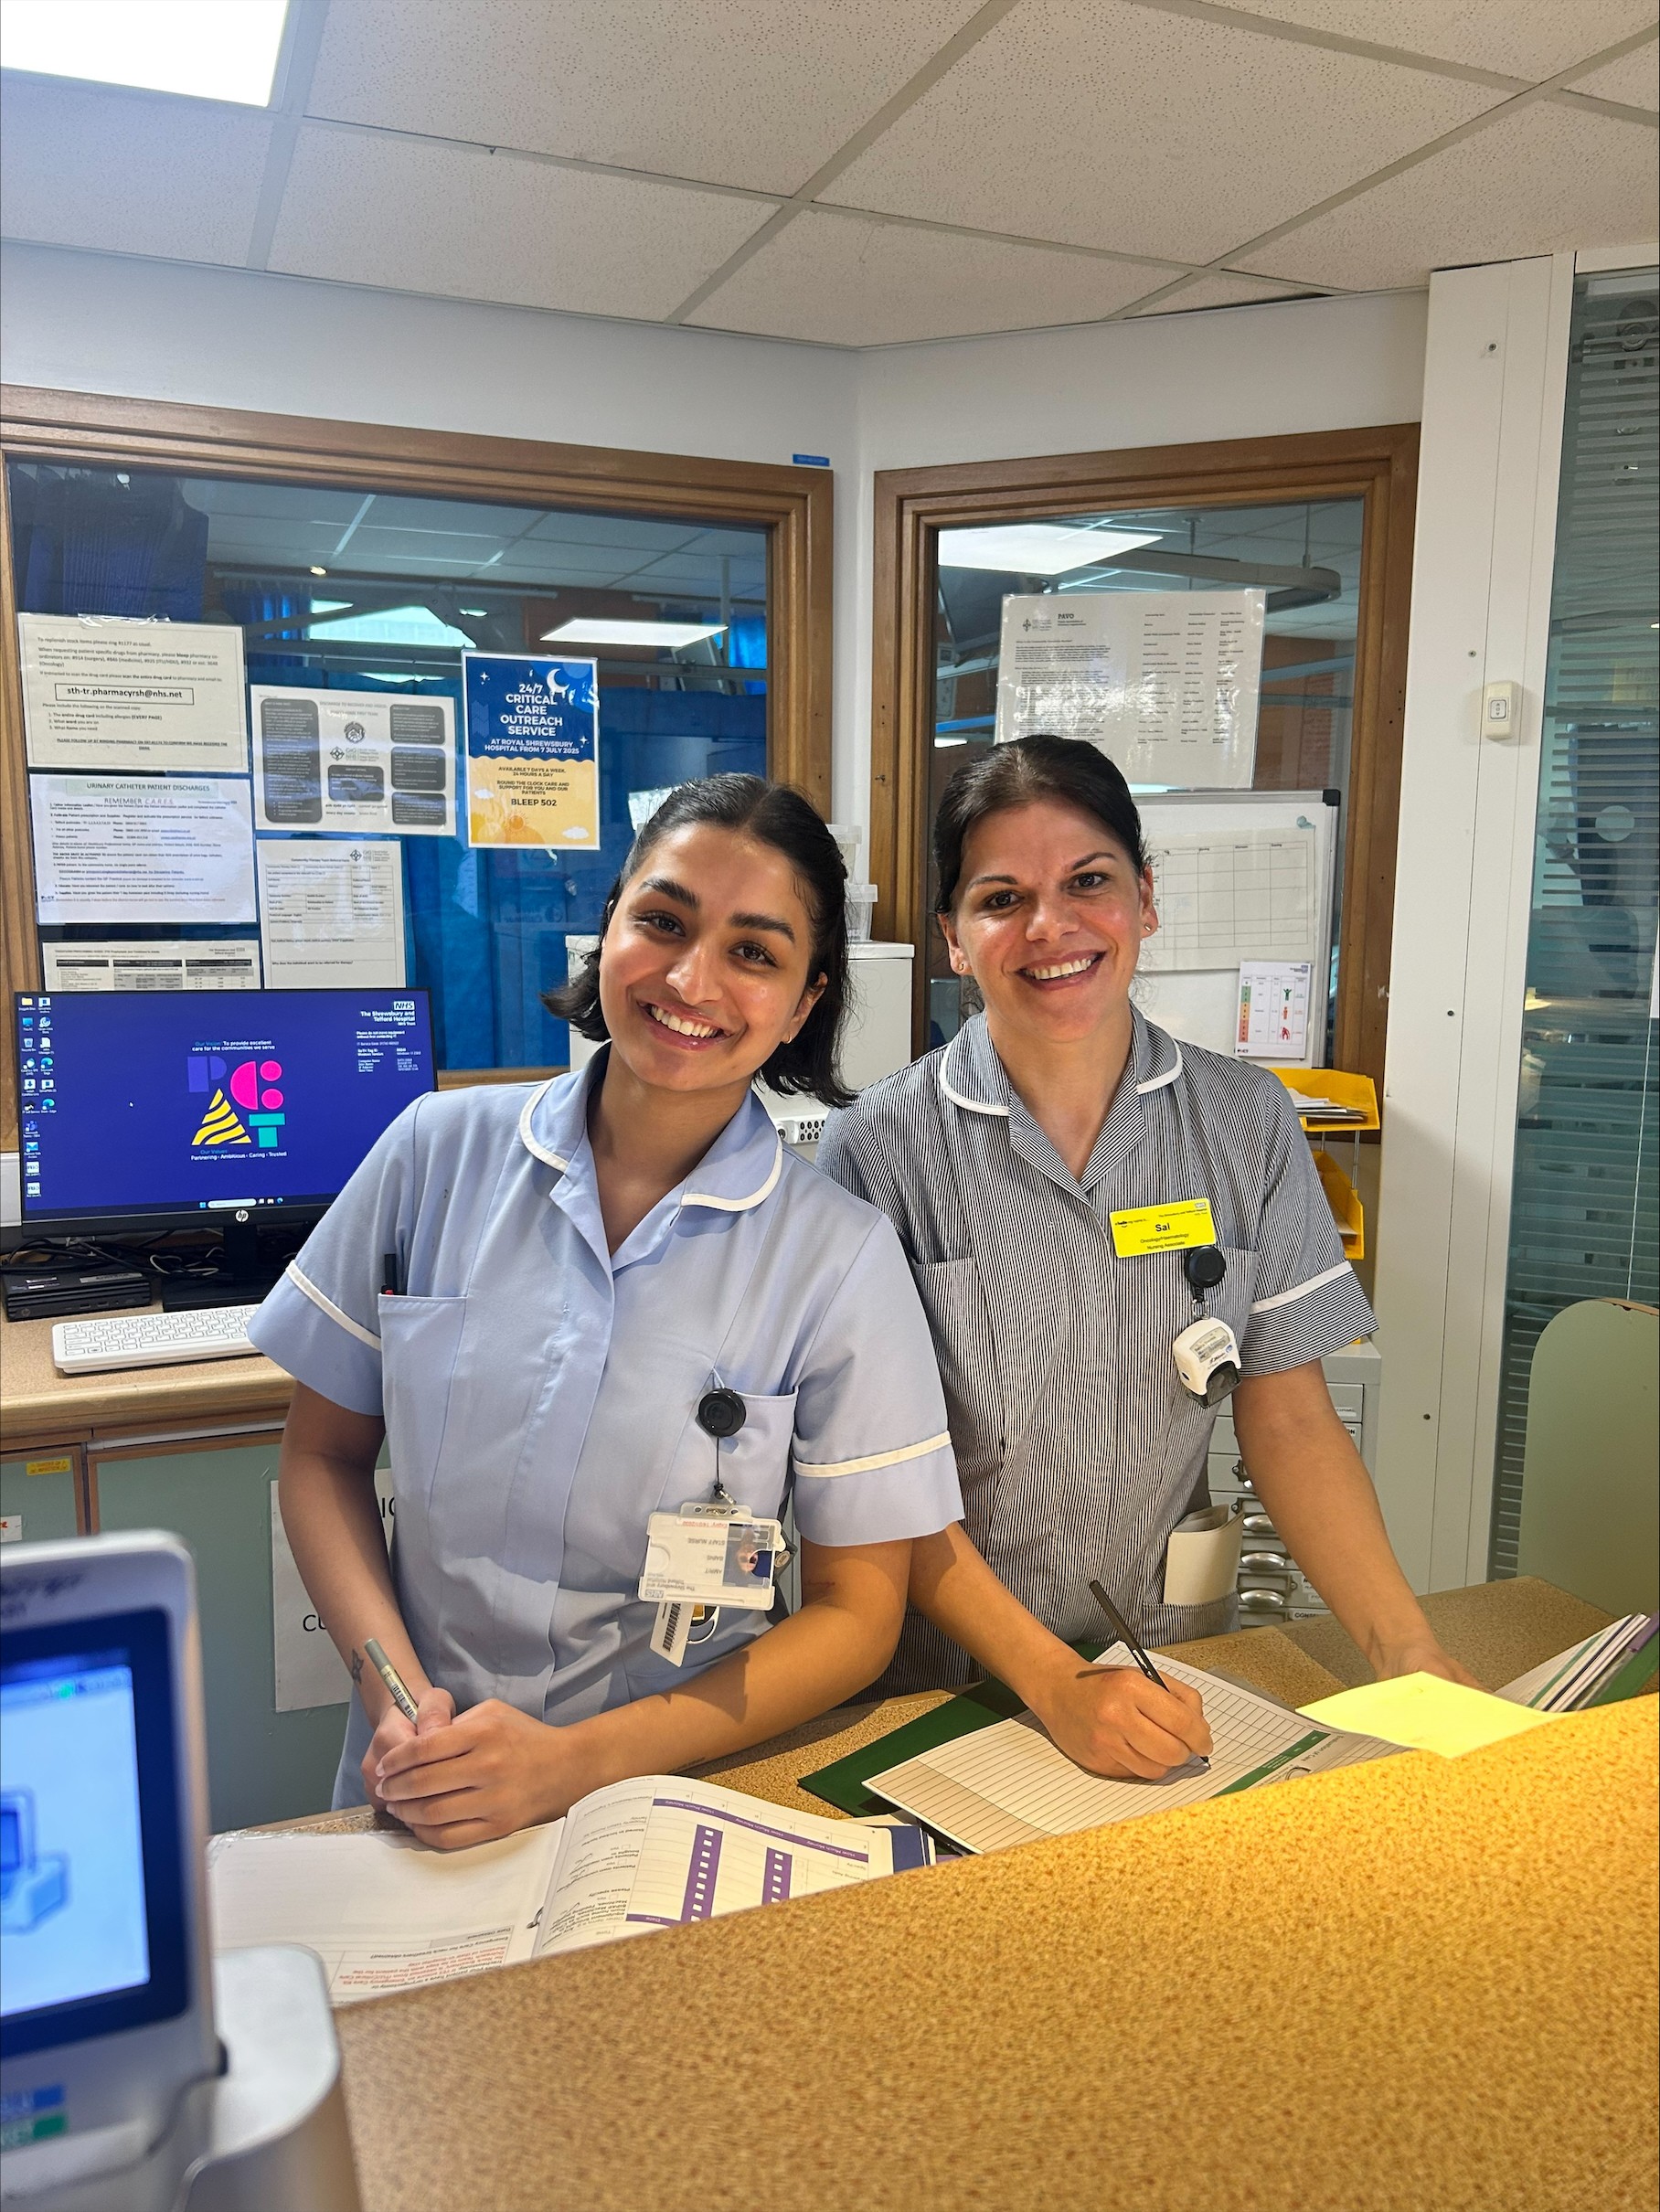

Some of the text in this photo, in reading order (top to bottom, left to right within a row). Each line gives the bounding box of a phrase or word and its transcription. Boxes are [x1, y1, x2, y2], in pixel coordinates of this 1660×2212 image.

[519, 684, 544, 695] 24/7
[505, 694, 558, 706] CRITICAL
[516, 705, 548, 715] CARE
[500, 715, 563, 727] OUTREACH
[508, 726, 557, 737] SERVICE
[526, 739, 574, 748] SHREWSBURY
[395, 1002, 414, 1010] NHS
[235, 1209, 250, 1223] hp
[1155, 1222, 1171, 1232] Sal
[645, 1590, 664, 1599] NHS
[467, 1931, 495, 1940] Obtained
[475, 1937, 509, 1945] Emergency
